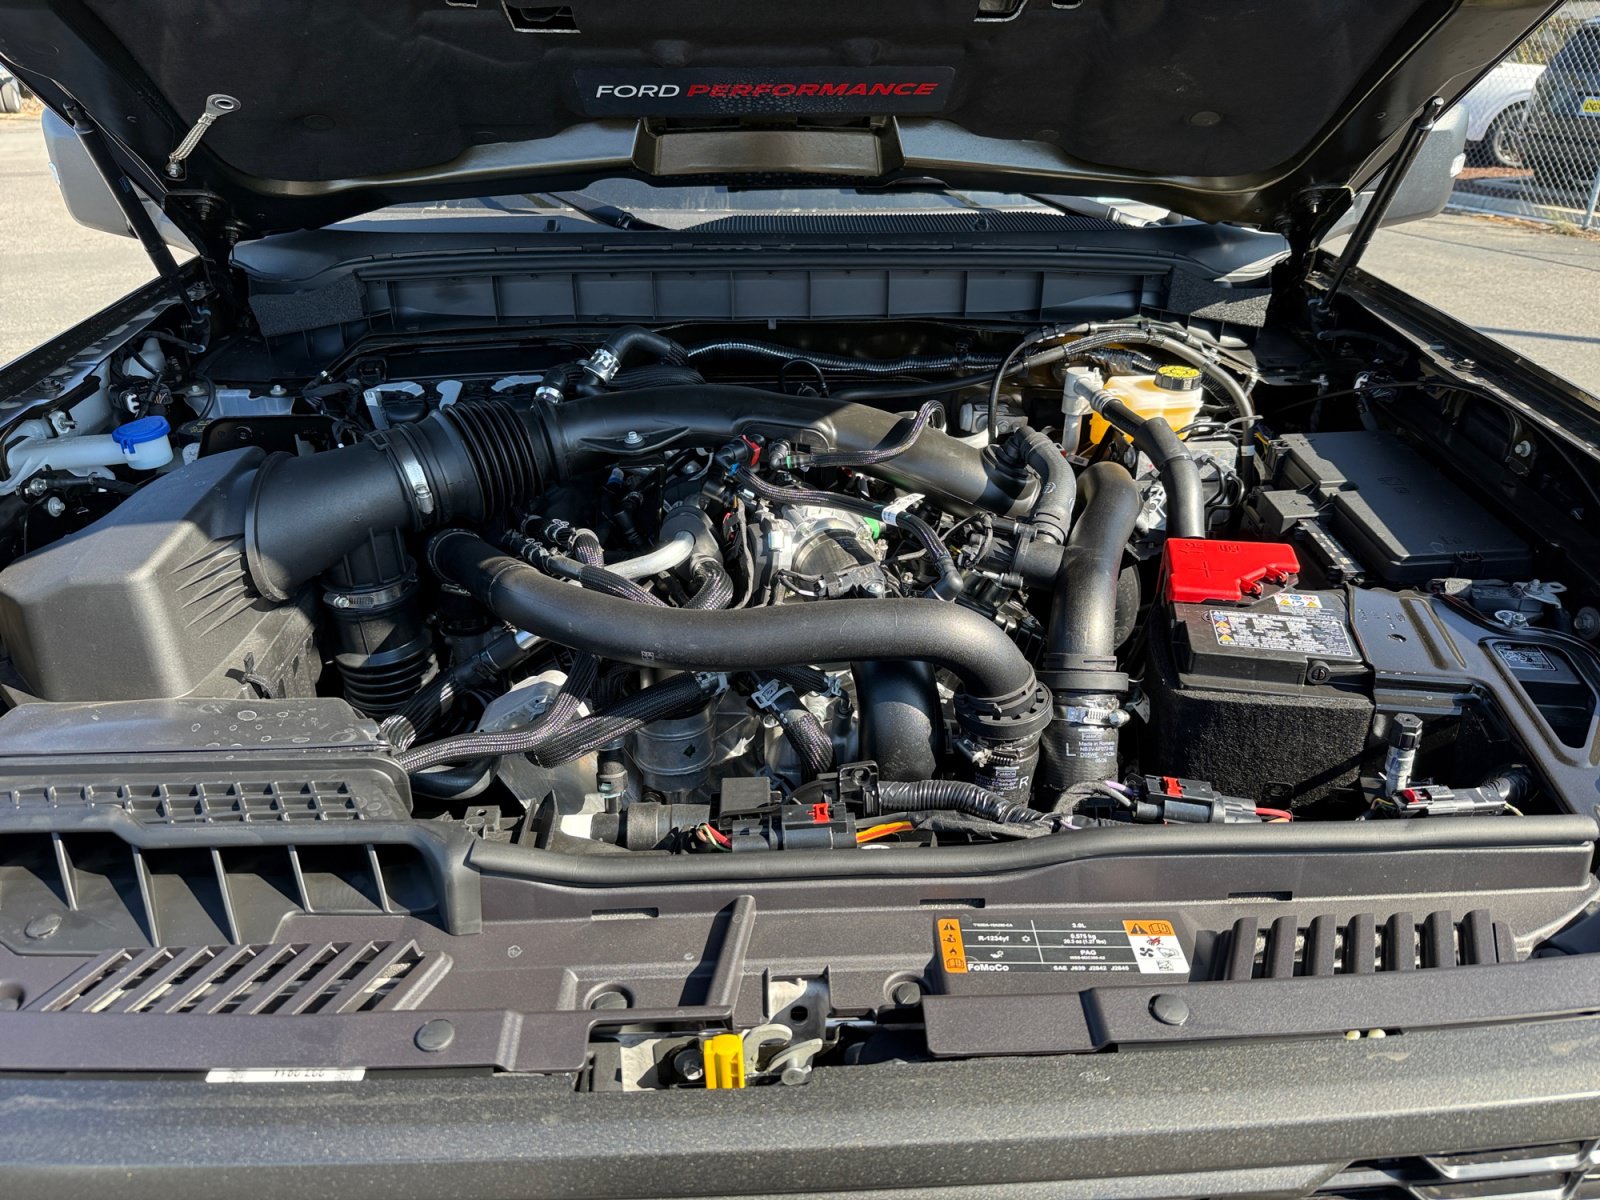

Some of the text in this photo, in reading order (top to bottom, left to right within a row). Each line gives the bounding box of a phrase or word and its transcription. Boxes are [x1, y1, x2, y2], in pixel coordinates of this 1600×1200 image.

[595, 83, 938, 98] FORD PERFORMANCE
[1065, 742, 1077, 757] L
[1019, 775, 1029, 789] R
[978, 935, 1010, 943] R-1234yf
[967, 963, 1009, 972] FoMoCo
